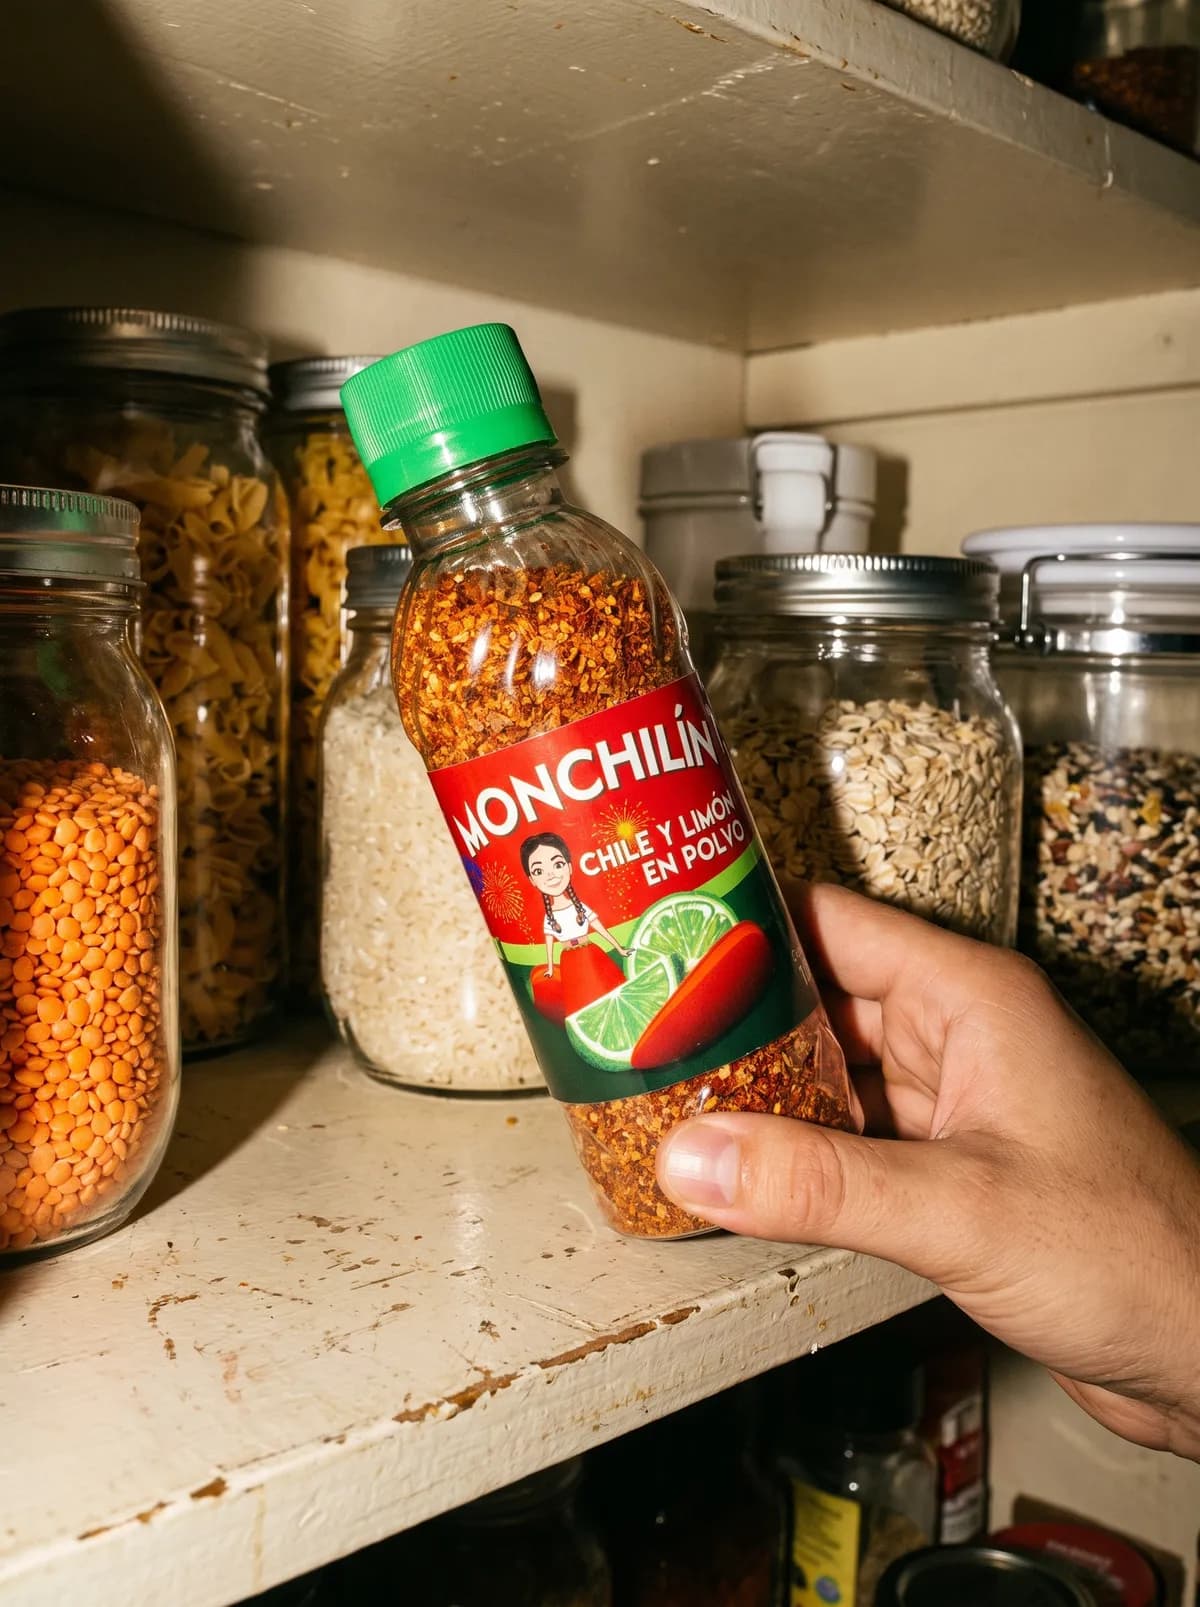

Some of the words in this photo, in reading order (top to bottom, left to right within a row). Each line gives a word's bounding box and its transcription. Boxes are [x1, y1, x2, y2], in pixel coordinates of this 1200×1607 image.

[453, 703, 718, 858] MONCHILÍN
[579, 830, 655, 876] CHILE
[656, 819, 674, 846] Y
[678, 789, 735, 838] LIMÓN
[643, 852, 680, 887] EN
[681, 819, 745, 870] POLVO
